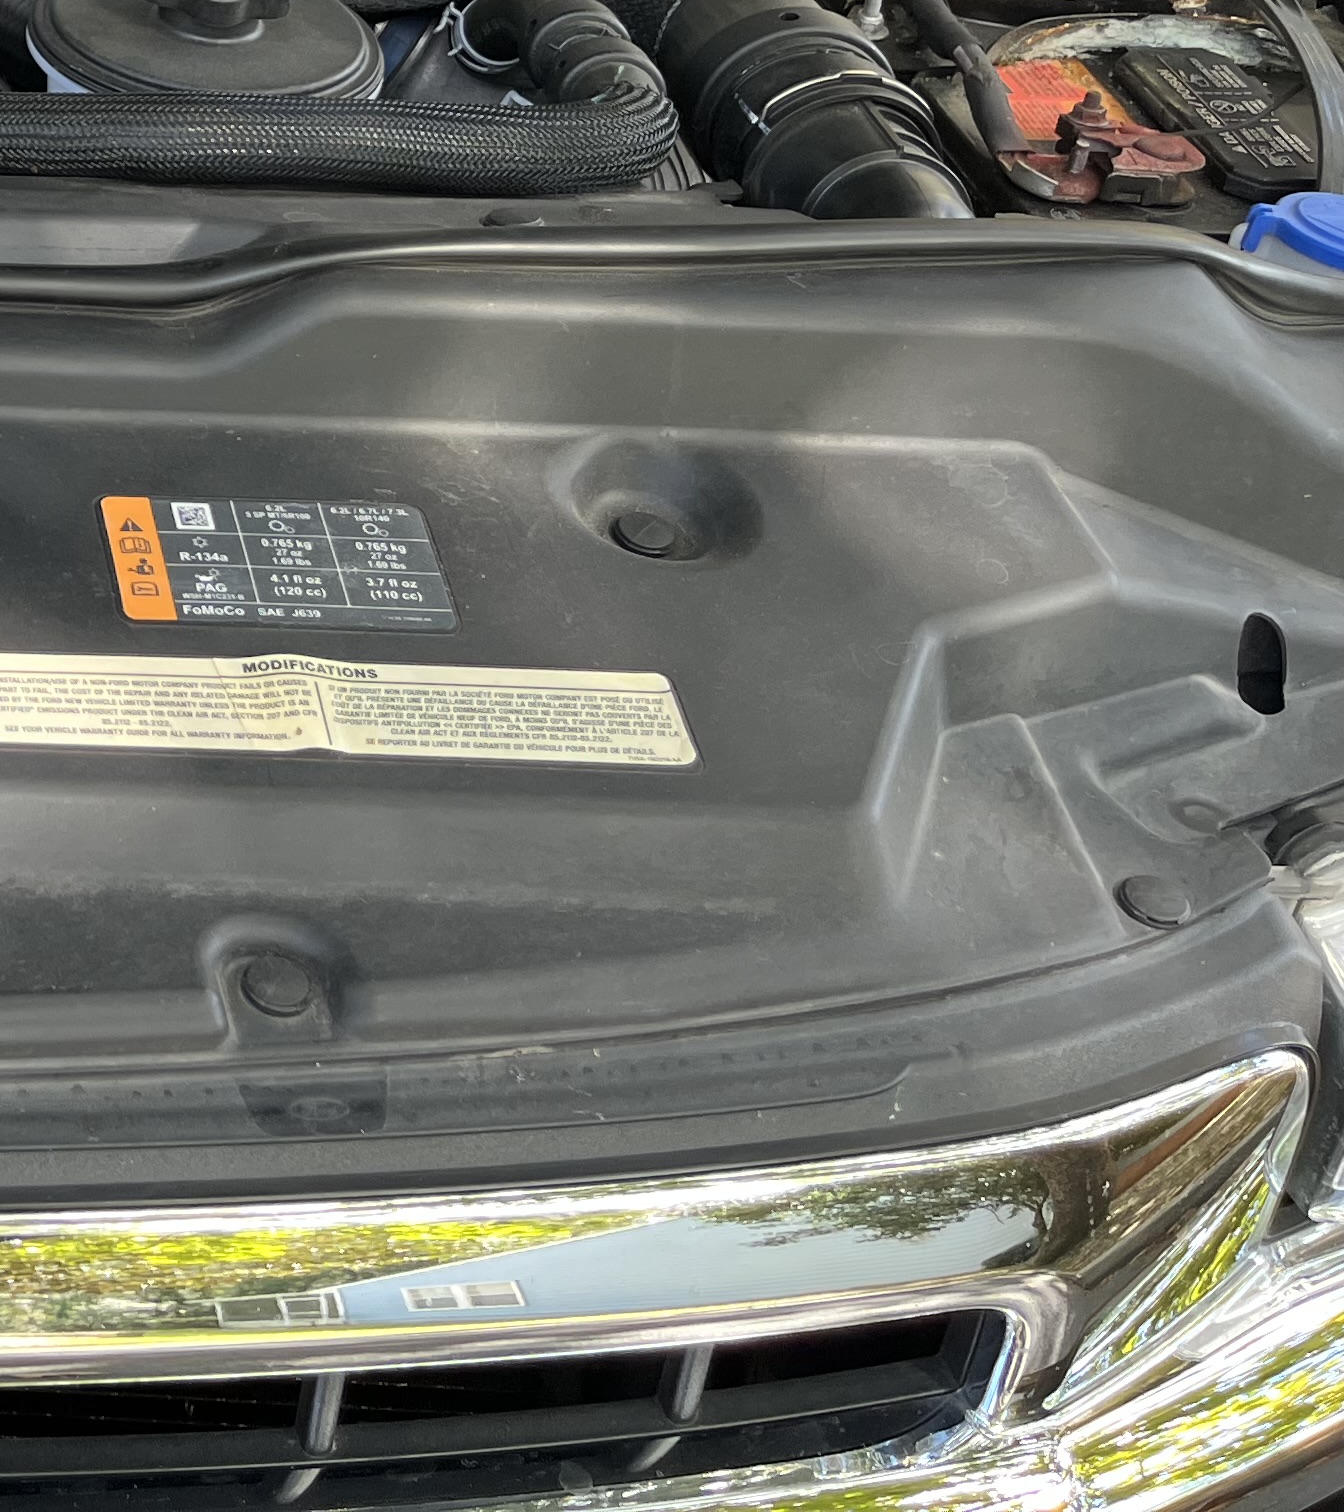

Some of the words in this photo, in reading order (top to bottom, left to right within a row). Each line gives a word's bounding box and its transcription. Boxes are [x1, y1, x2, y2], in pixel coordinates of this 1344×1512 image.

[261, 538, 293, 548] 0.765
[296, 540, 312, 551] kg
[356, 541, 387, 551] 0.765
[391, 543, 406, 555] kg
[180, 552, 229, 563] R-134a
[275, 548, 286, 557] 27
[371, 552, 381, 560] 27
[294, 557, 311, 566] lbs
[390, 561, 406, 570] lbs
[270, 574, 288, 583] 4.1
[291, 574, 303, 584] fl
[306, 576, 322, 585] oz
[366, 577, 384, 587] 3.7
[388, 577, 398, 587] fl
[401, 579, 418, 588] oz
[196, 582, 227, 593] PAG
[274, 586, 303, 598] (120
[306, 587, 327, 599] cc)
[370, 590, 399, 602] (110
[402, 591, 423, 603] cc)
[183, 604, 245, 617] FoMoCo
[258, 607, 286, 617] SAE
[292, 607, 321, 618] J639
[241, 659, 378, 679] MODIFICATIONS
